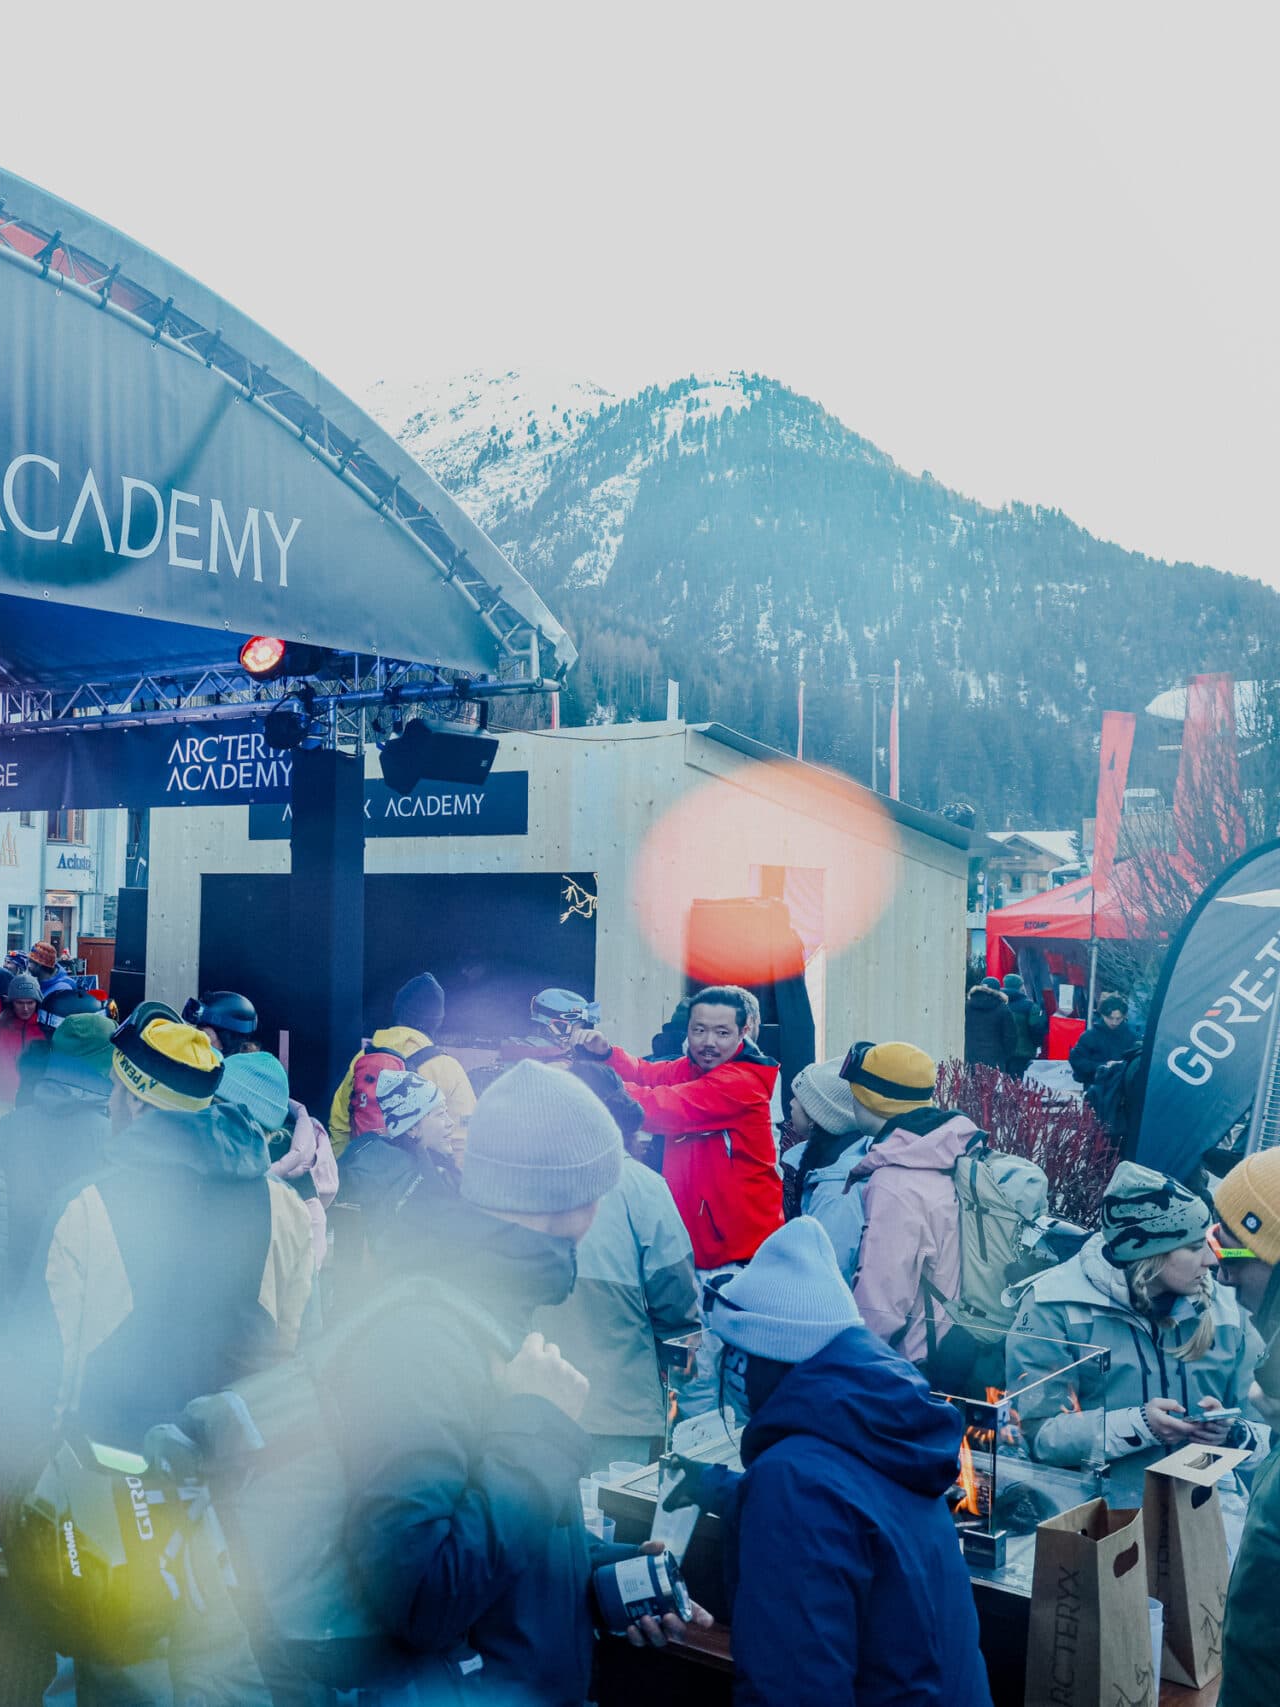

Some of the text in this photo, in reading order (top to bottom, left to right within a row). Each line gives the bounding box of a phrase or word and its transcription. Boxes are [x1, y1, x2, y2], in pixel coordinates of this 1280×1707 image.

[167, 733, 292, 765] ARC'TER
[166, 760, 293, 792] ACADEMY
[384, 793, 485, 818] ACADEMY
[1167, 929, 1280, 1086] GORE-T
[125, 1476, 154, 1541] GIRO
[63, 1521, 82, 1577] ATOMIC
